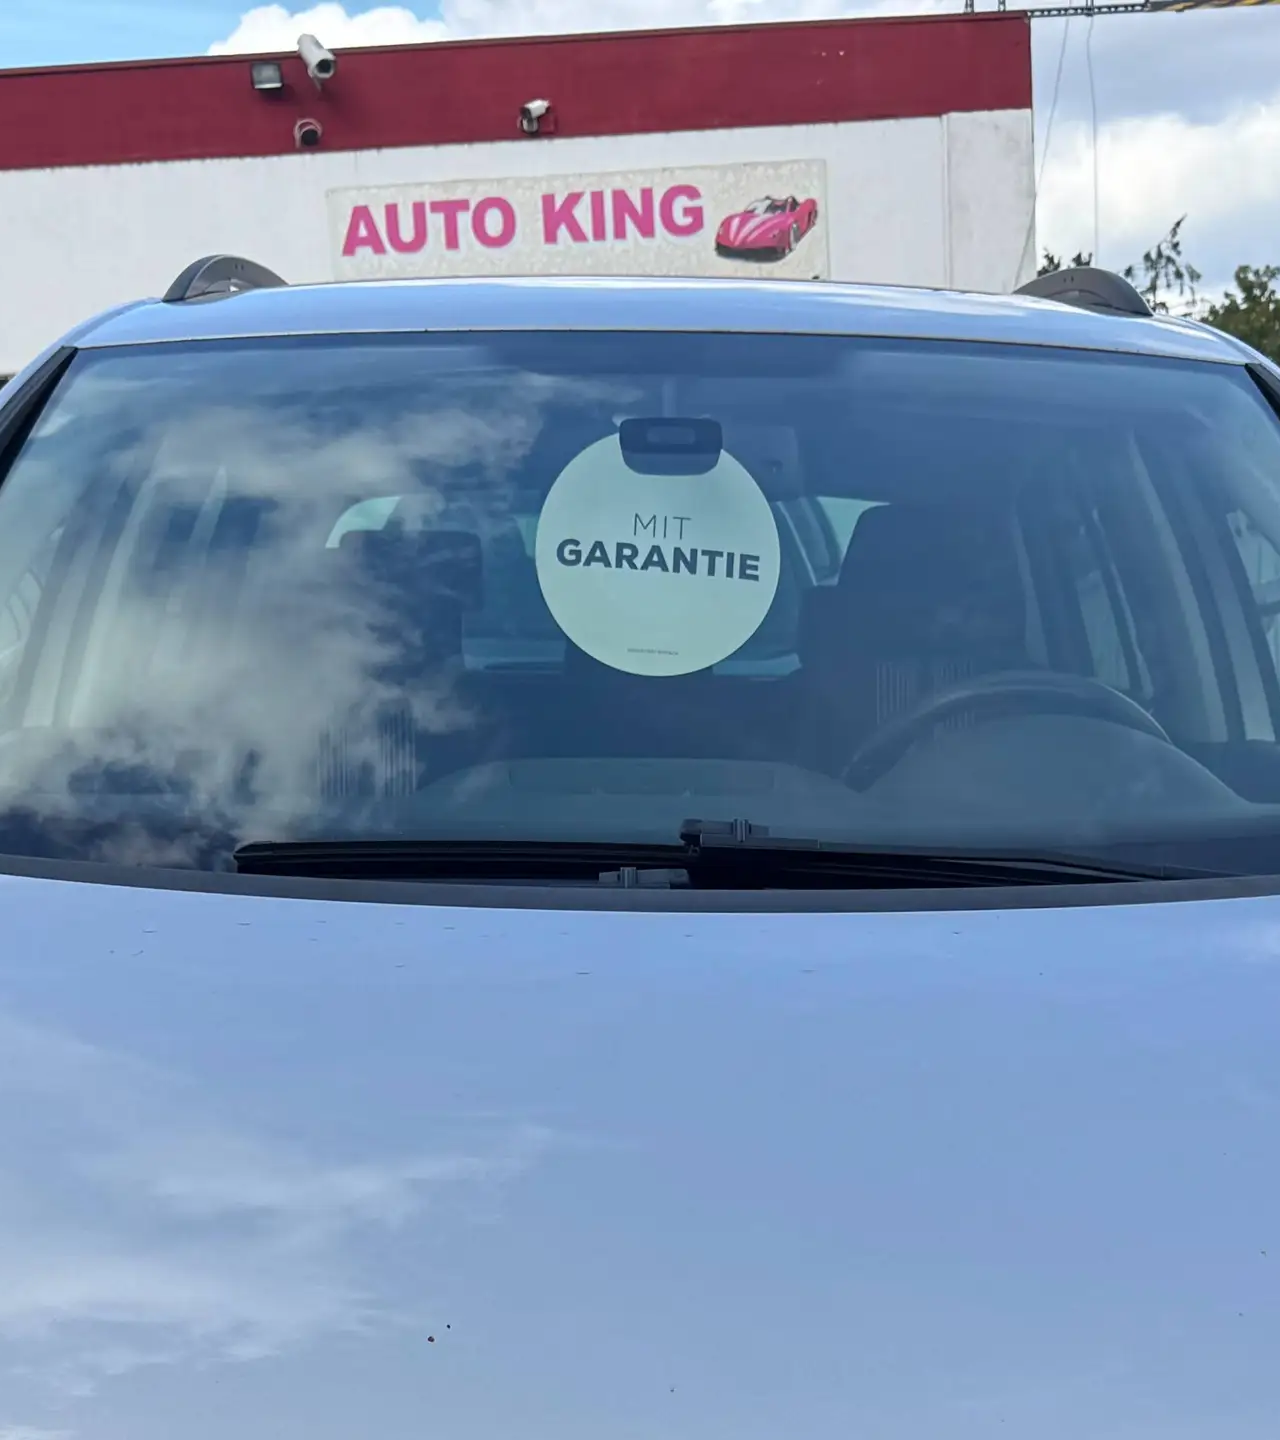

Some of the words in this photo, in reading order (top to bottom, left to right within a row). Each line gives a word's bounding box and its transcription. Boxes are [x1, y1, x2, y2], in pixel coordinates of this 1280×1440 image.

[341, 196, 516, 257] AUTO
[541, 184, 705, 246] KING
[633, 513, 692, 540] MIT
[556, 538, 761, 582] GARANTIE
